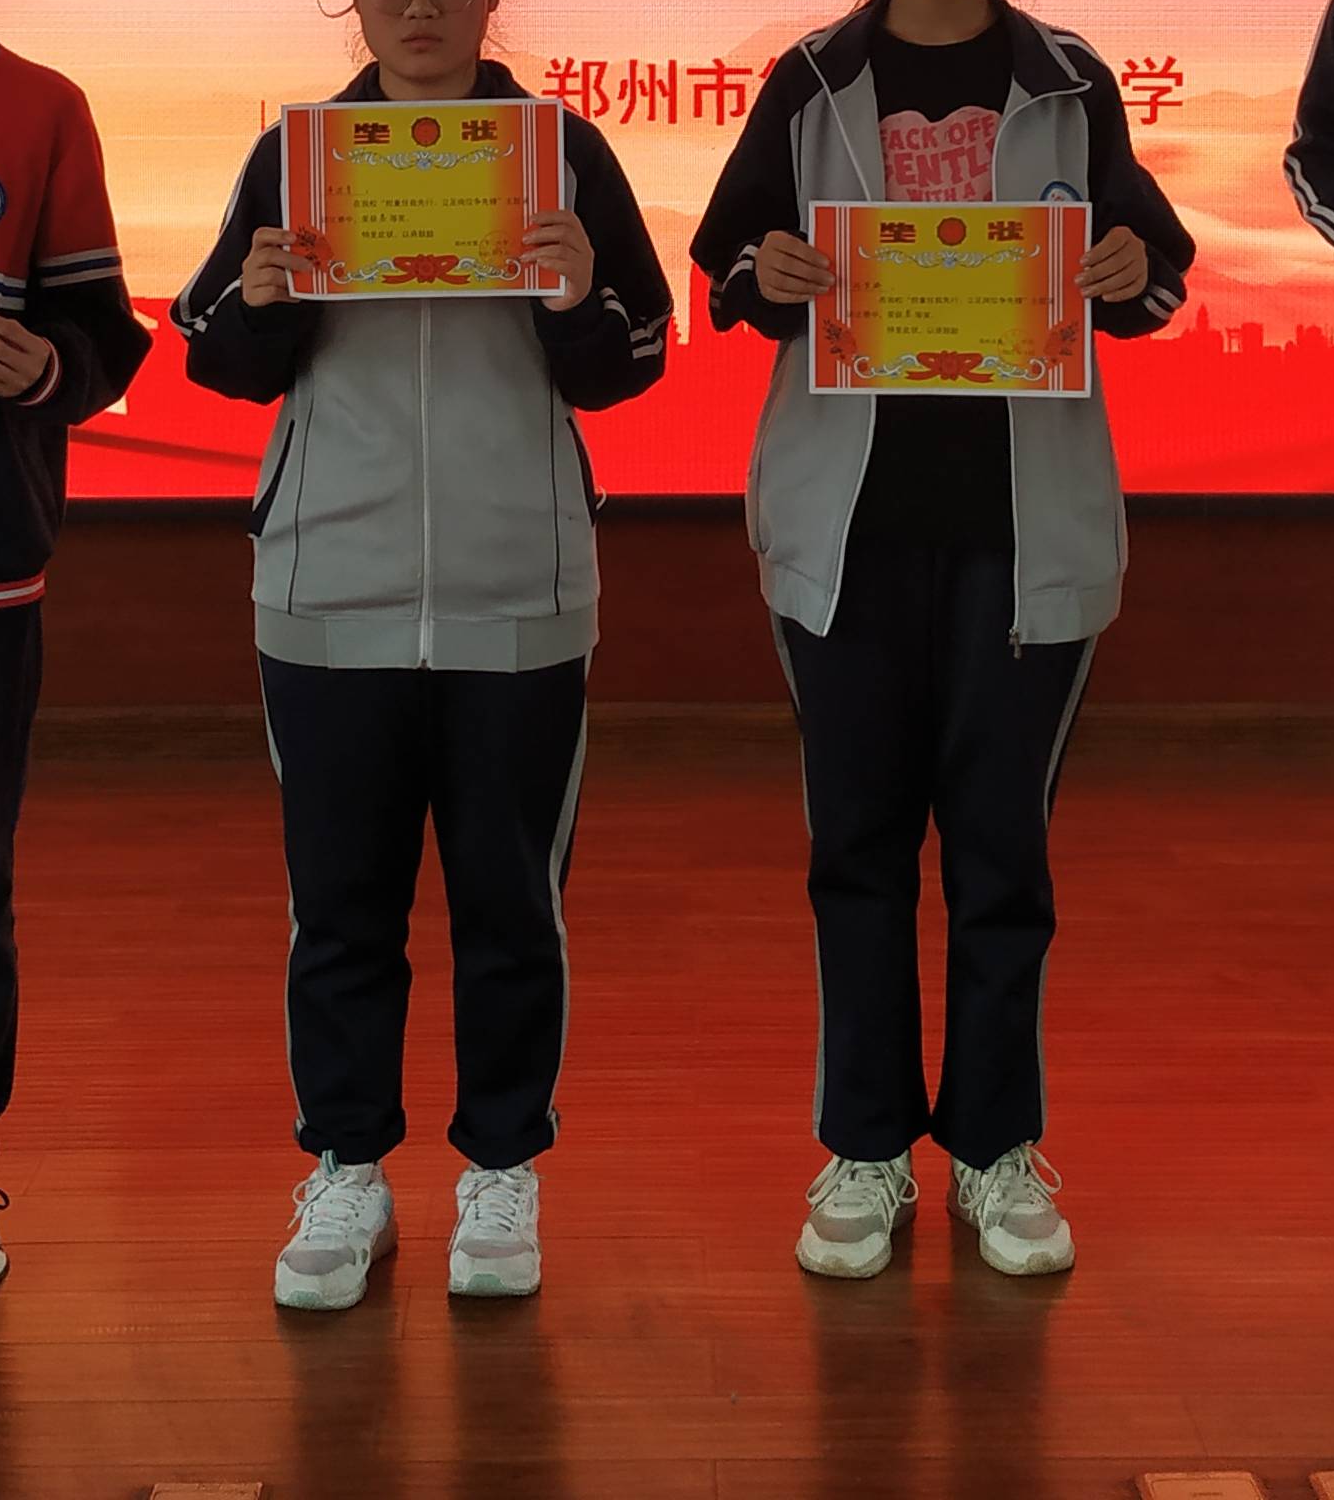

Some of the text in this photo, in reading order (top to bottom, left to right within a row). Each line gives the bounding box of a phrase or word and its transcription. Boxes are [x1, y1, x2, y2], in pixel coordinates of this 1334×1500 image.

[542, 57, 776, 126] 郑州市
[948, 113, 995, 146] OFF
